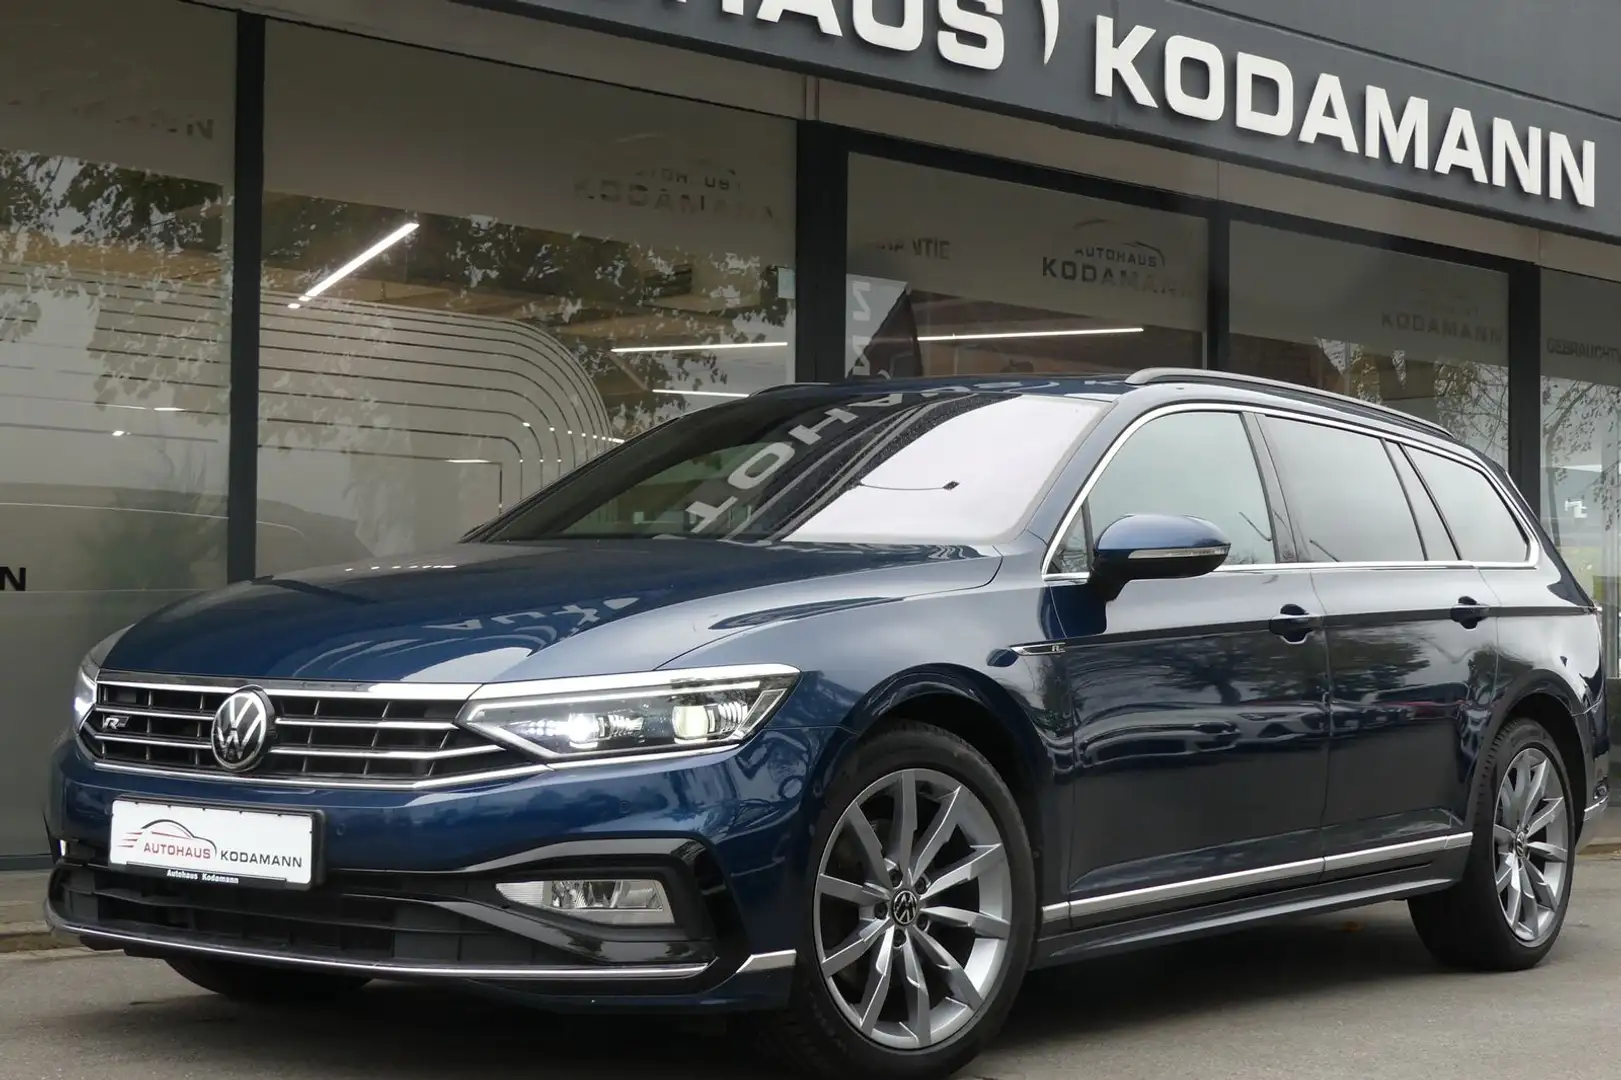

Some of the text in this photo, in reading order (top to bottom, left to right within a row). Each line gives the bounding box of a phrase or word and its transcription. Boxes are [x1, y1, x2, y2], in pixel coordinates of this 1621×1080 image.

[1094, 14, 1596, 208] KODAMANN
[143, 841, 303, 868] AUTOHAUS KODAMANN
[166, 869, 239, 884] Autohaus Kodamann
